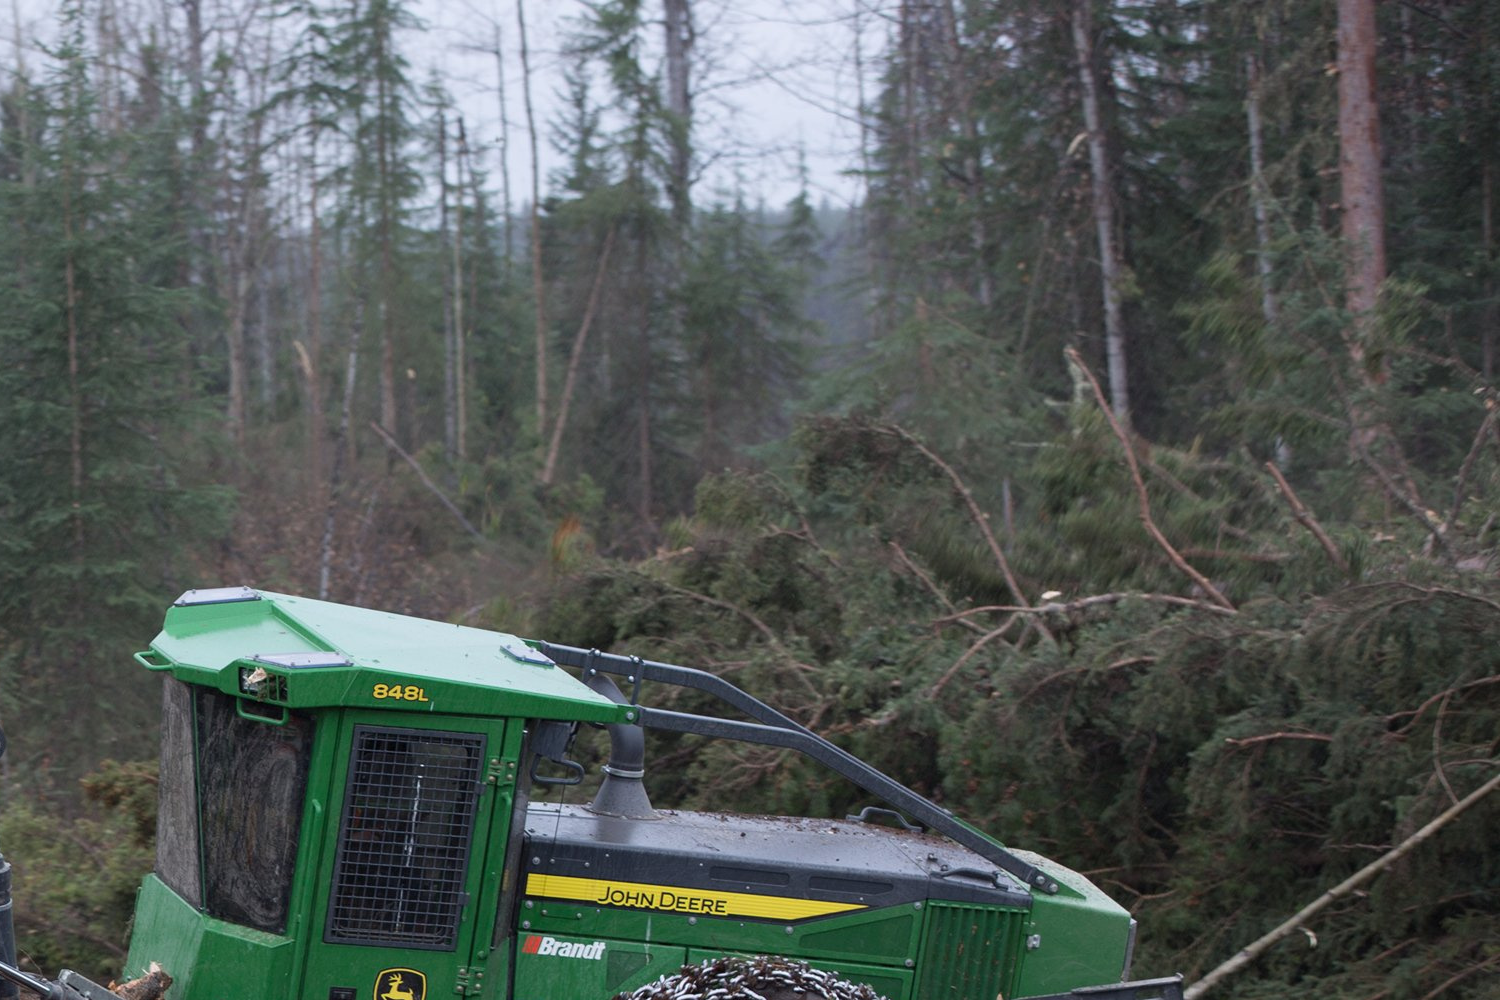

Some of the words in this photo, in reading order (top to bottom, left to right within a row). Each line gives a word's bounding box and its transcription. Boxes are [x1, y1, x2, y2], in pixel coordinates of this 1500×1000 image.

[373, 683, 429, 702] 848L
[597, 886, 655, 906] JOHN
[659, 891, 728, 913] DEERE
[537, 936, 606, 960] Brandt
